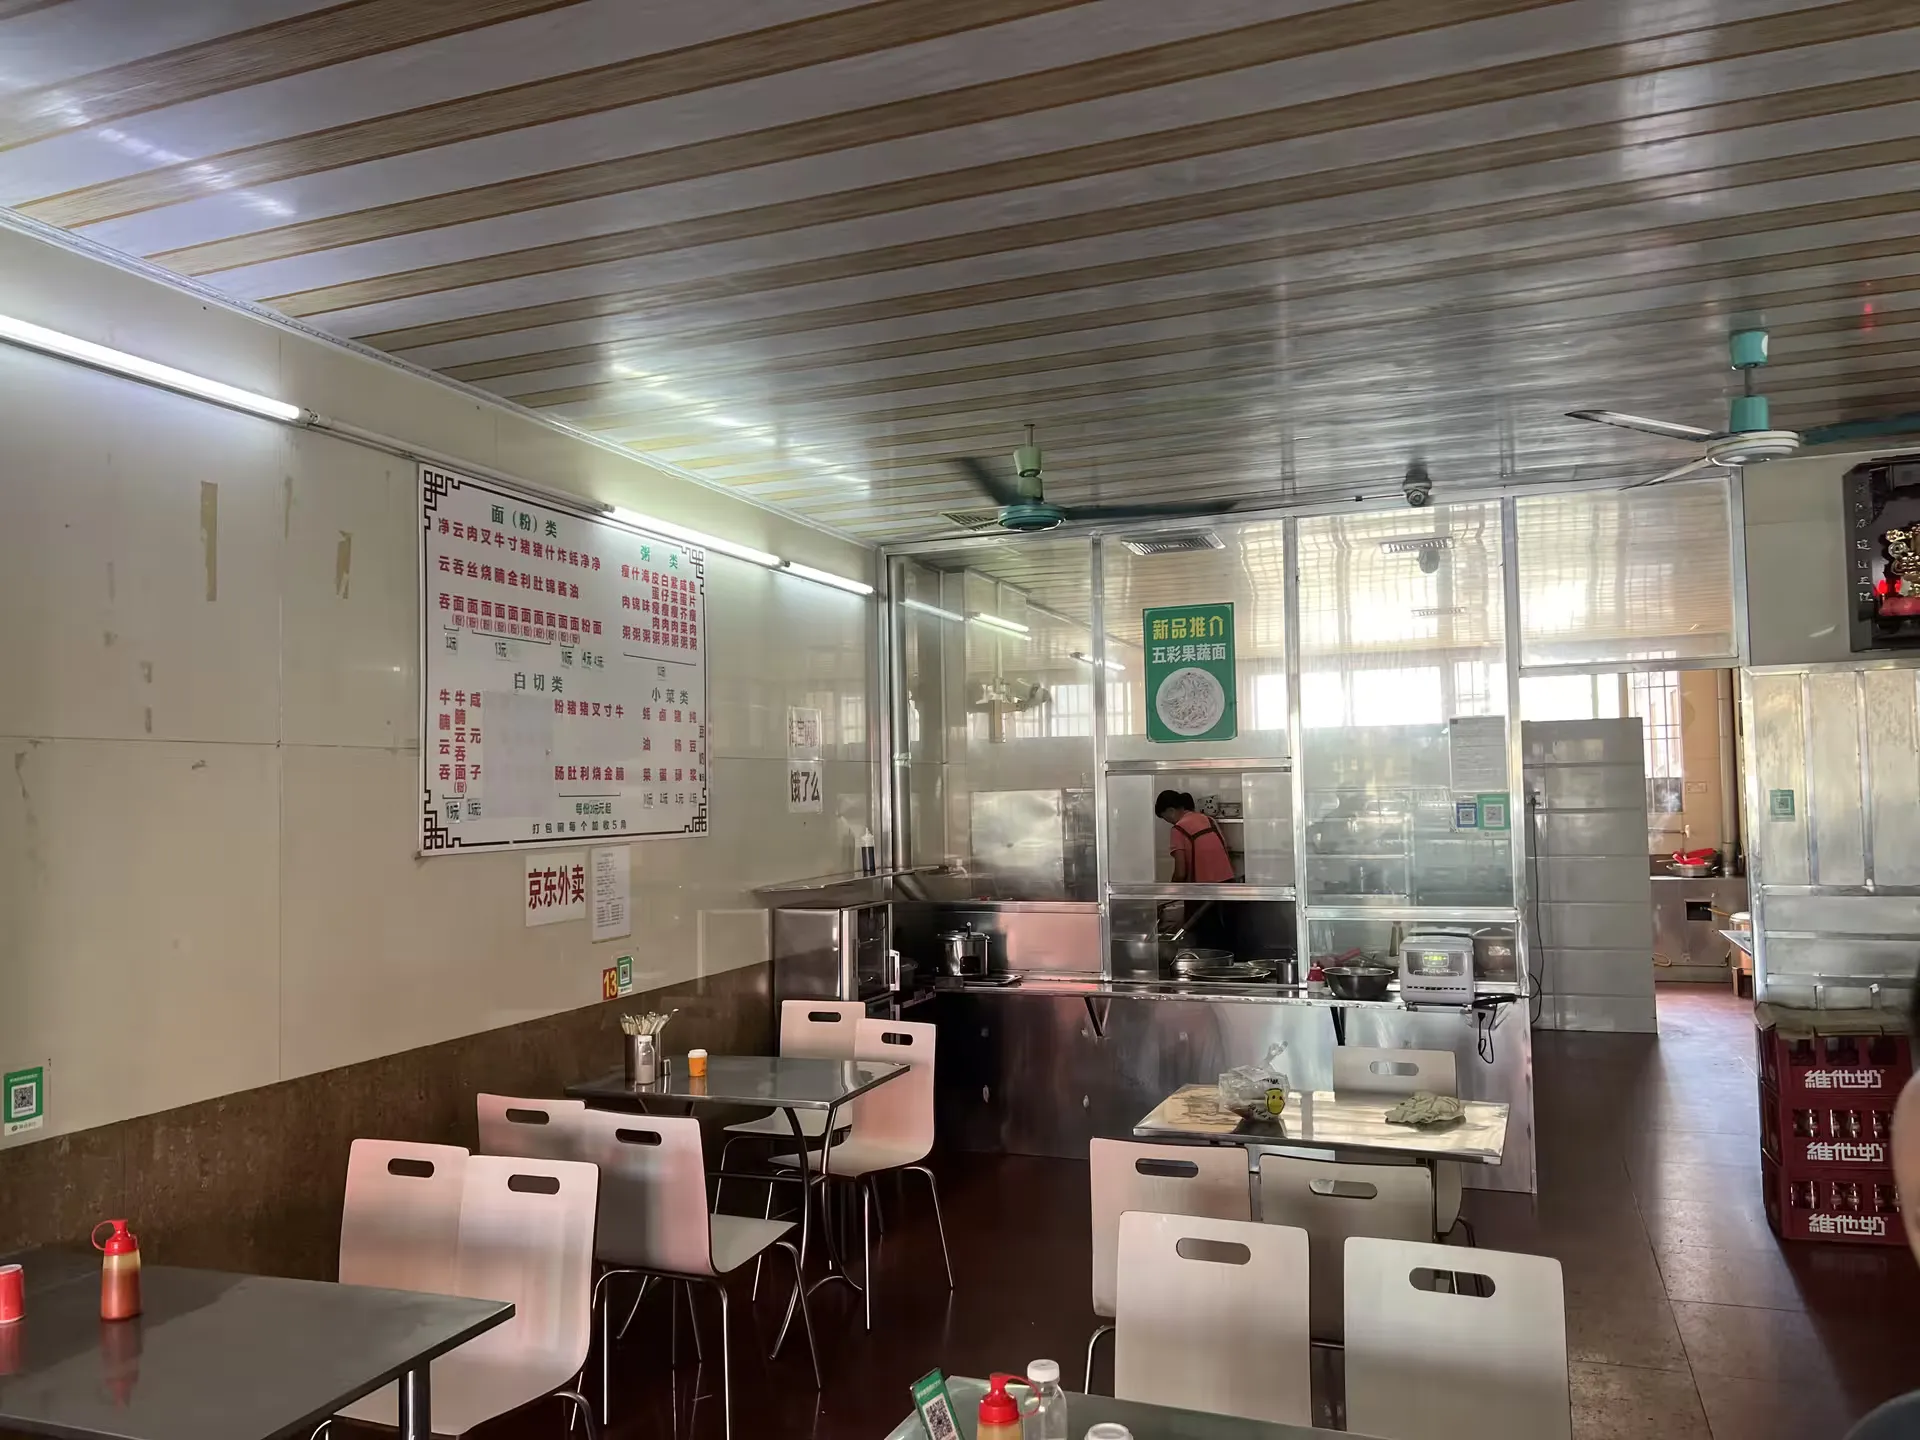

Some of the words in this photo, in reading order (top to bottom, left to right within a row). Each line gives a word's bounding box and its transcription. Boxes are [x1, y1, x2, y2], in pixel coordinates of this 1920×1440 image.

[1151, 643, 1226, 664] 五彩果蔬面
[513, 671, 563, 693] 白切类
[651, 687, 689, 705] 小菜类
[790, 769, 820, 803] 饿了么
[528, 864, 584, 910] 京东外卖
[603, 969, 618, 998] 13
[1804, 1069, 1882, 1089] 維他奶
[1807, 1141, 1884, 1162] 維他奶
[1809, 1213, 1885, 1236] 維他奶
